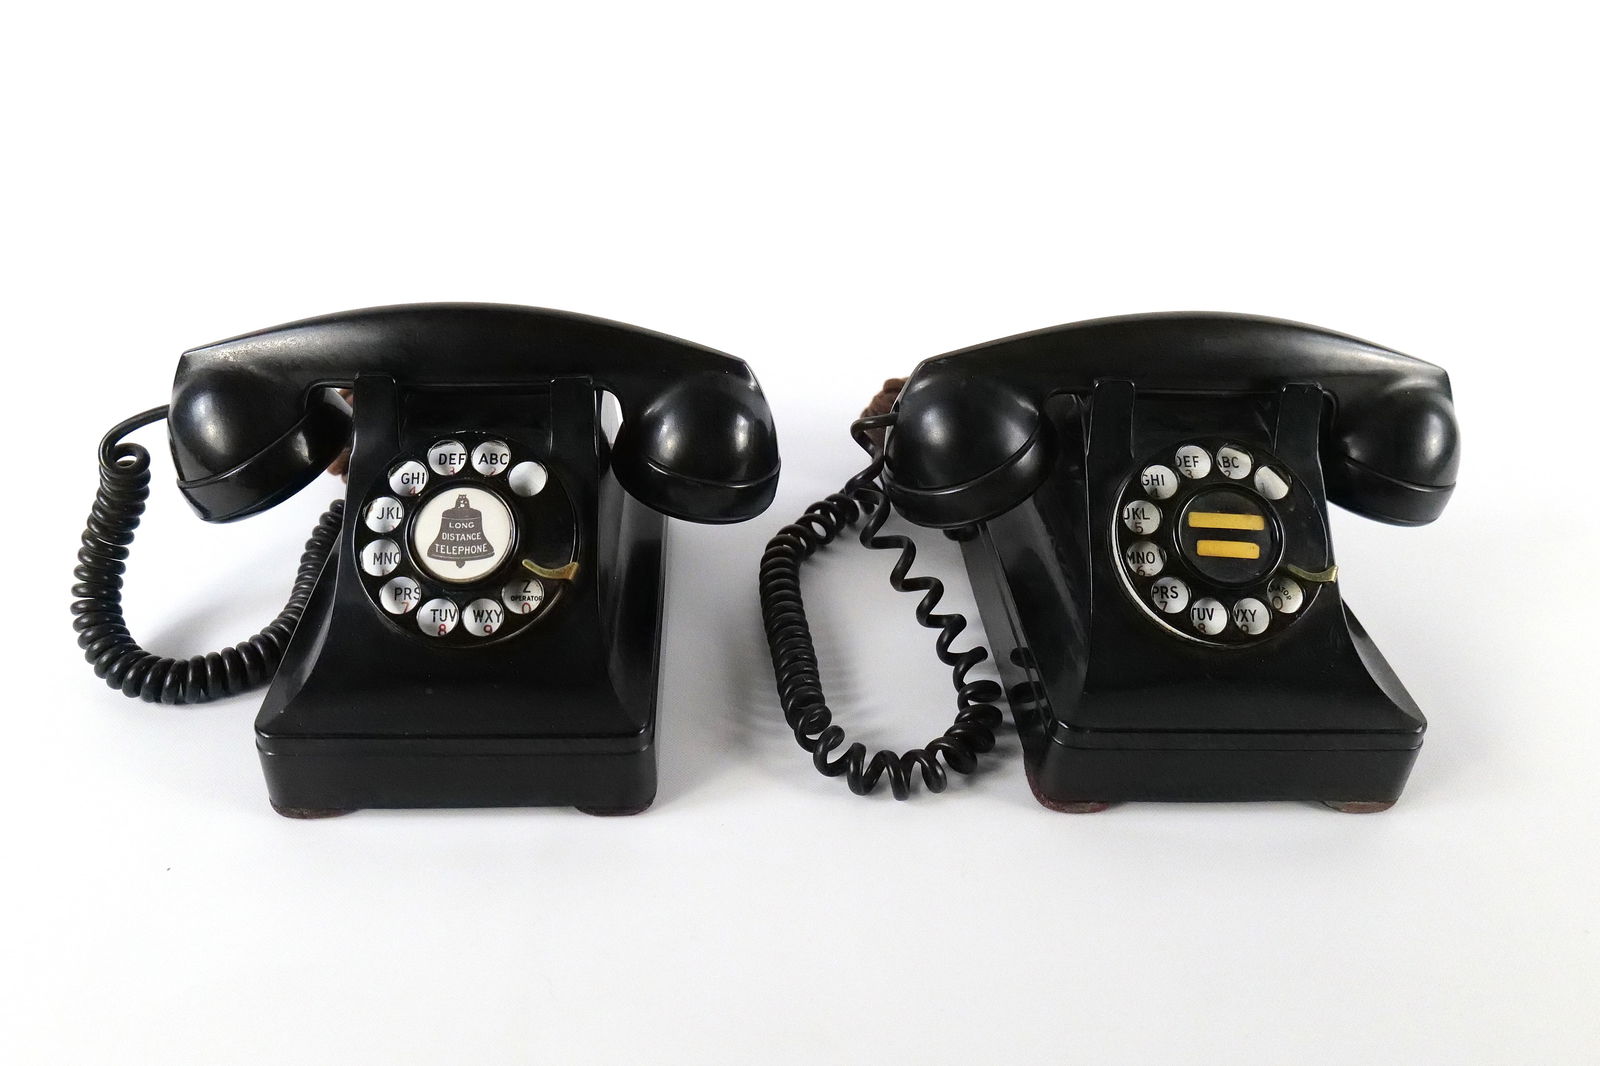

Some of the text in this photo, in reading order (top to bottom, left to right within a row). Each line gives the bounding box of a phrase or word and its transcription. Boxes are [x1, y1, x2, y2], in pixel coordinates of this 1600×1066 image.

[438, 453, 466, 466] DEF
[478, 453, 509, 465] ABC
[401, 472, 425, 485] GHI
[1142, 473, 1165, 486] GHI
[408, 486, 416, 496] 4
[376, 506, 402, 520] JKL
[1124, 507, 1151, 520] JKL
[448, 521, 475, 529] LONG
[1134, 521, 1144, 534] 5
[441, 531, 482, 542] DISTANCE
[434, 543, 488, 555] TELEPHONE
[1126, 551, 1156, 565] MNO
[1136, 565, 1146, 577] 6
[394, 586, 420, 601] PRS
[522, 580, 532, 594] Z
[1151, 585, 1179, 600] PRS
[401, 601, 410, 614] 7
[521, 602, 532, 615] 0
[1159, 600, 1168, 613] 7
[1271, 595, 1284, 610] 0
[430, 608, 458, 623] TUV
[472, 608, 503, 623] WXY
[437, 623, 447, 636] 8
[483, 623, 493, 635] 9
